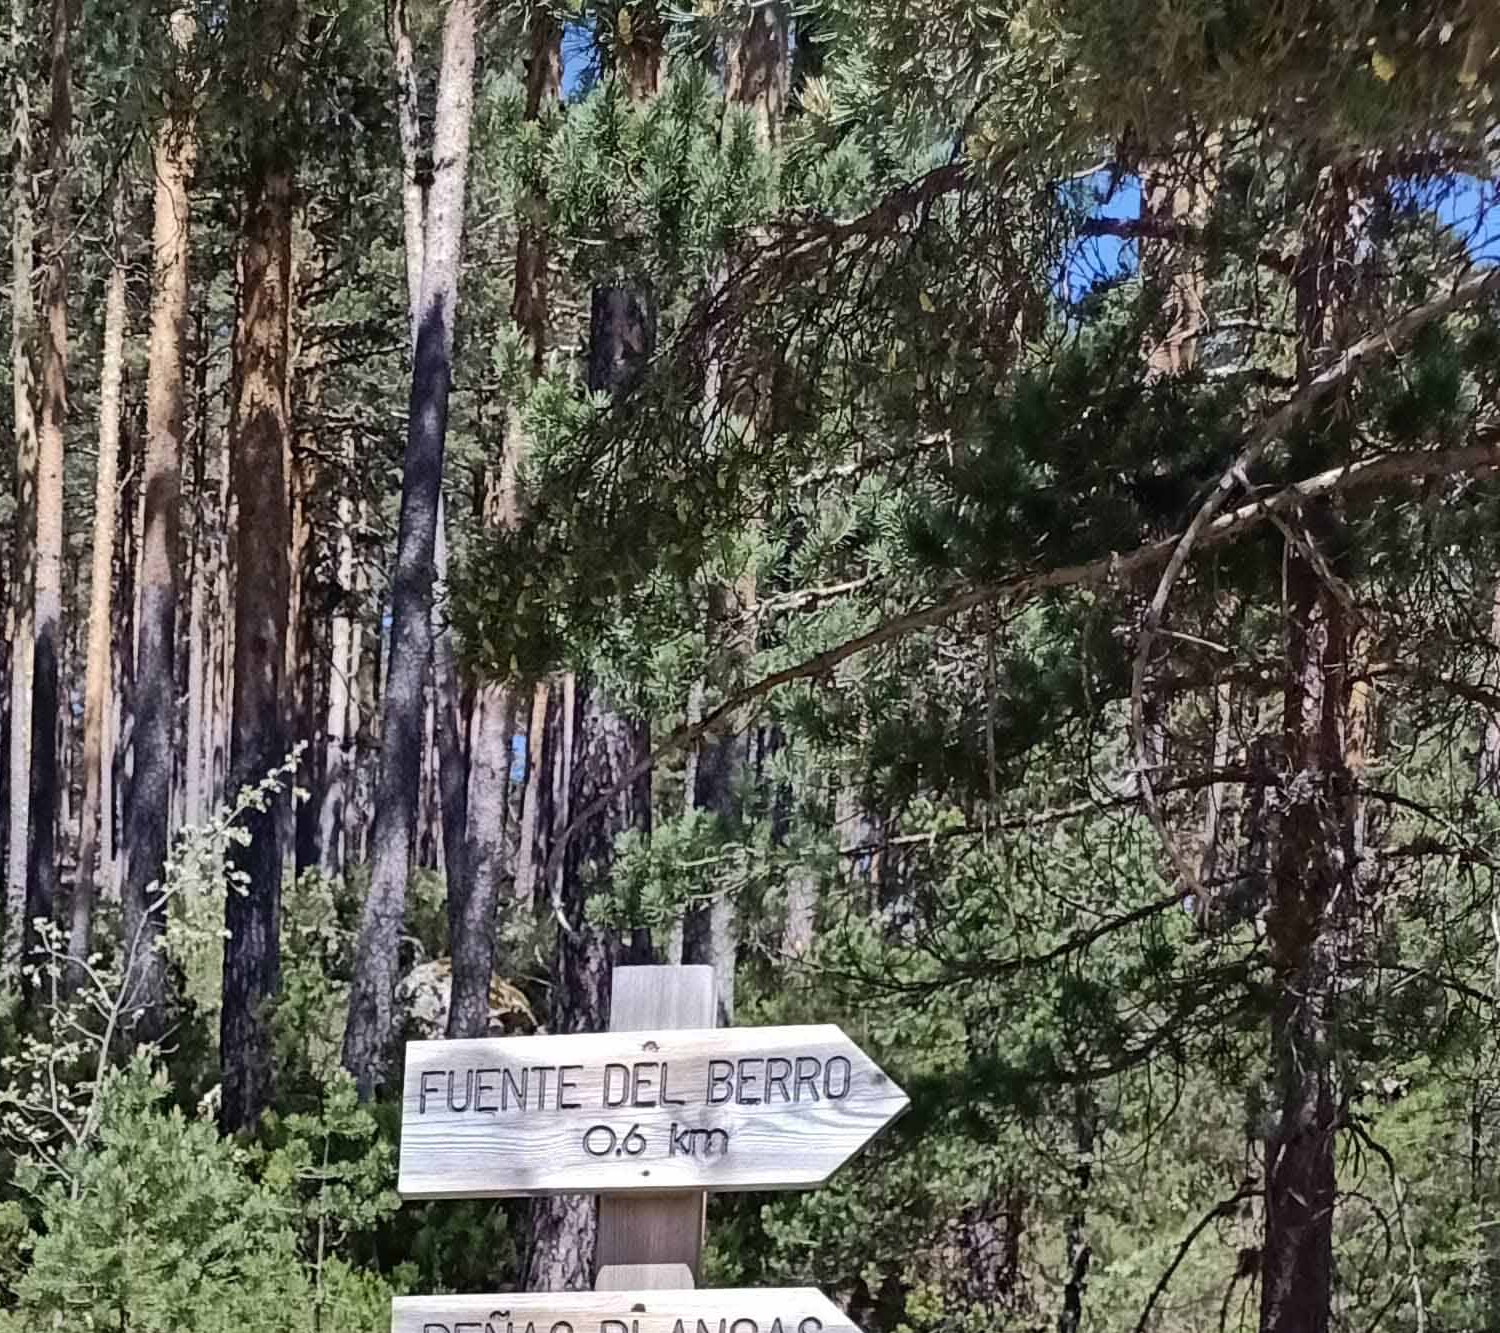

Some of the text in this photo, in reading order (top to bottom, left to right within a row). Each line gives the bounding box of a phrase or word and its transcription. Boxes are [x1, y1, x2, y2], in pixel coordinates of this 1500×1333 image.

[418, 1055, 852, 1114] FUENTE DEL BERRO
[582, 1122, 728, 1157] 0.6 km
